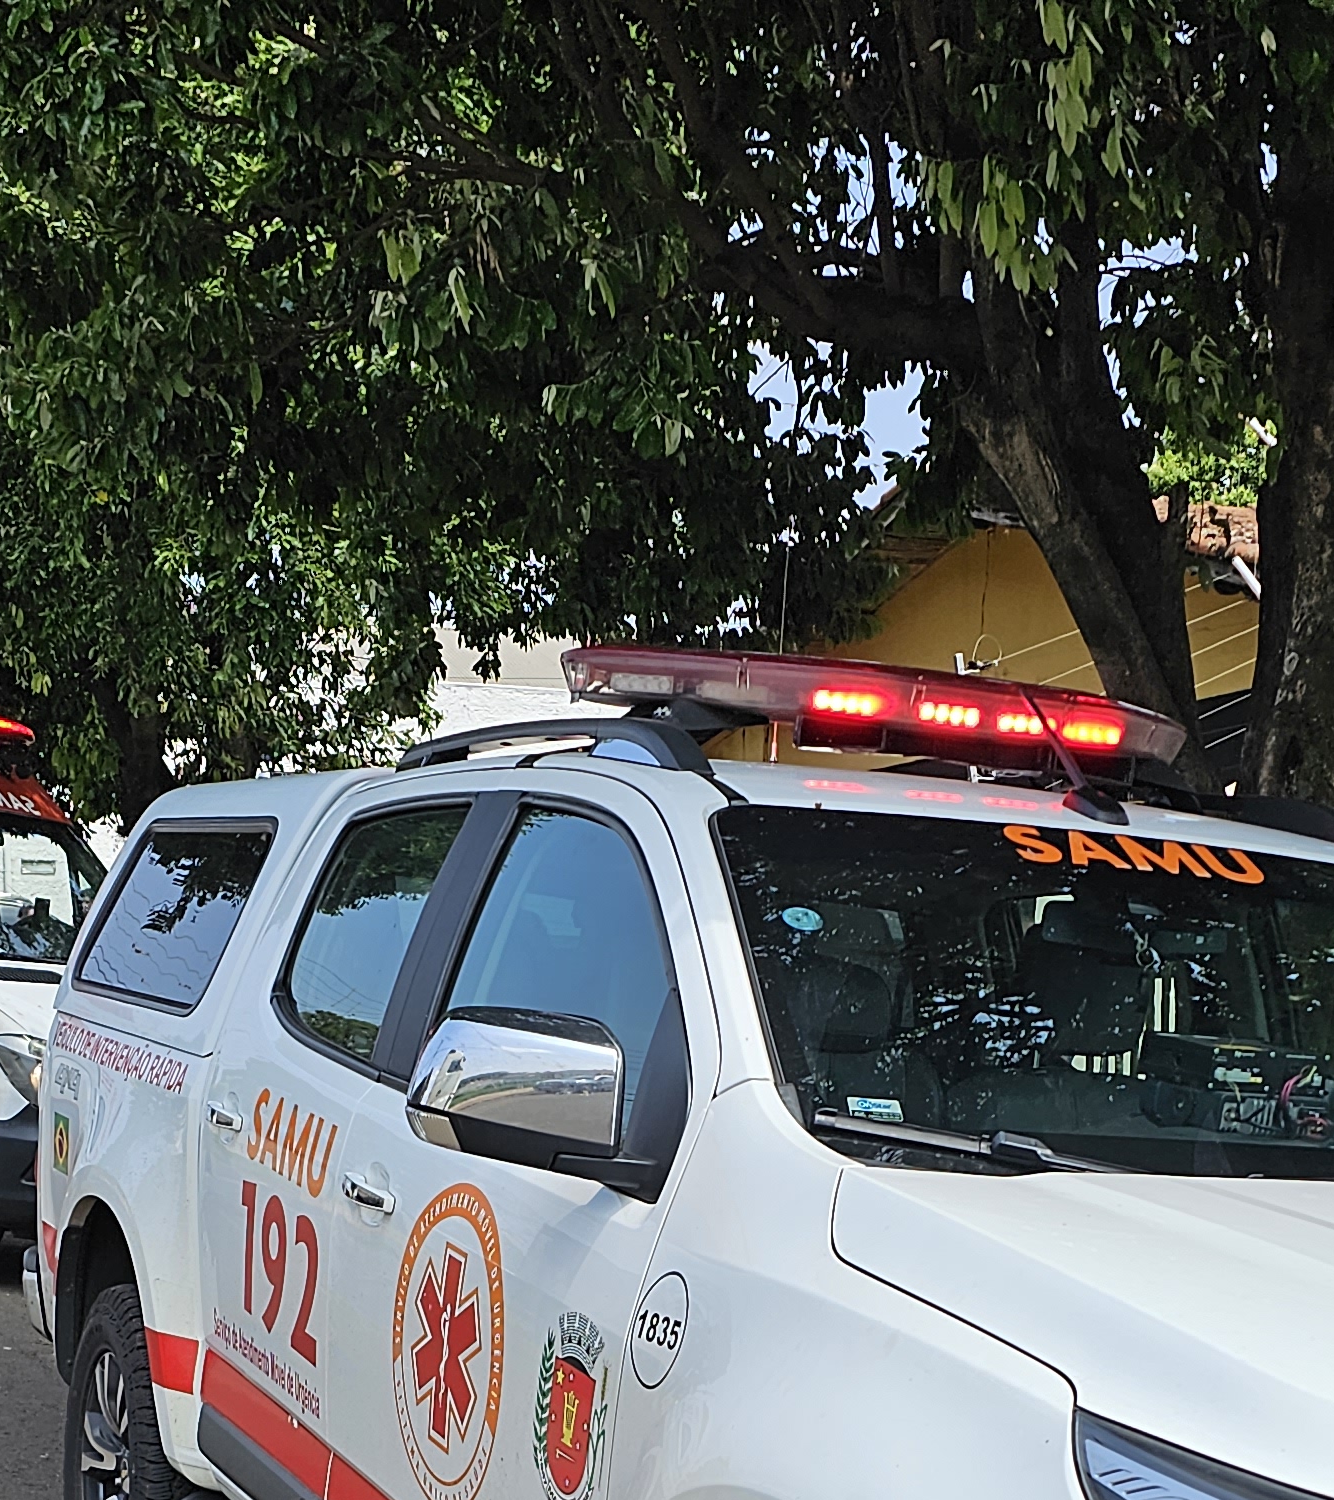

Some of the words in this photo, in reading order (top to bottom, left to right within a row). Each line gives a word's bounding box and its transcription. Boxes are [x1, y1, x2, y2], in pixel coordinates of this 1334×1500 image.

[1002, 824, 1265, 885] SAMU
[88, 1034, 152, 1081] INTERVENÇÃO
[145, 1049, 189, 1094] RÁPIDA
[246, 1087, 338, 1198] SAMU
[241, 1179, 318, 1368] 192
[394, 1263, 410, 1344] SERVIÇO
[409, 1235, 418, 1258] DE
[419, 1192, 479, 1235] ATENDIMENTO
[476, 1207, 495, 1261] MÓVEL
[637, 1309, 682, 1351] 1835
